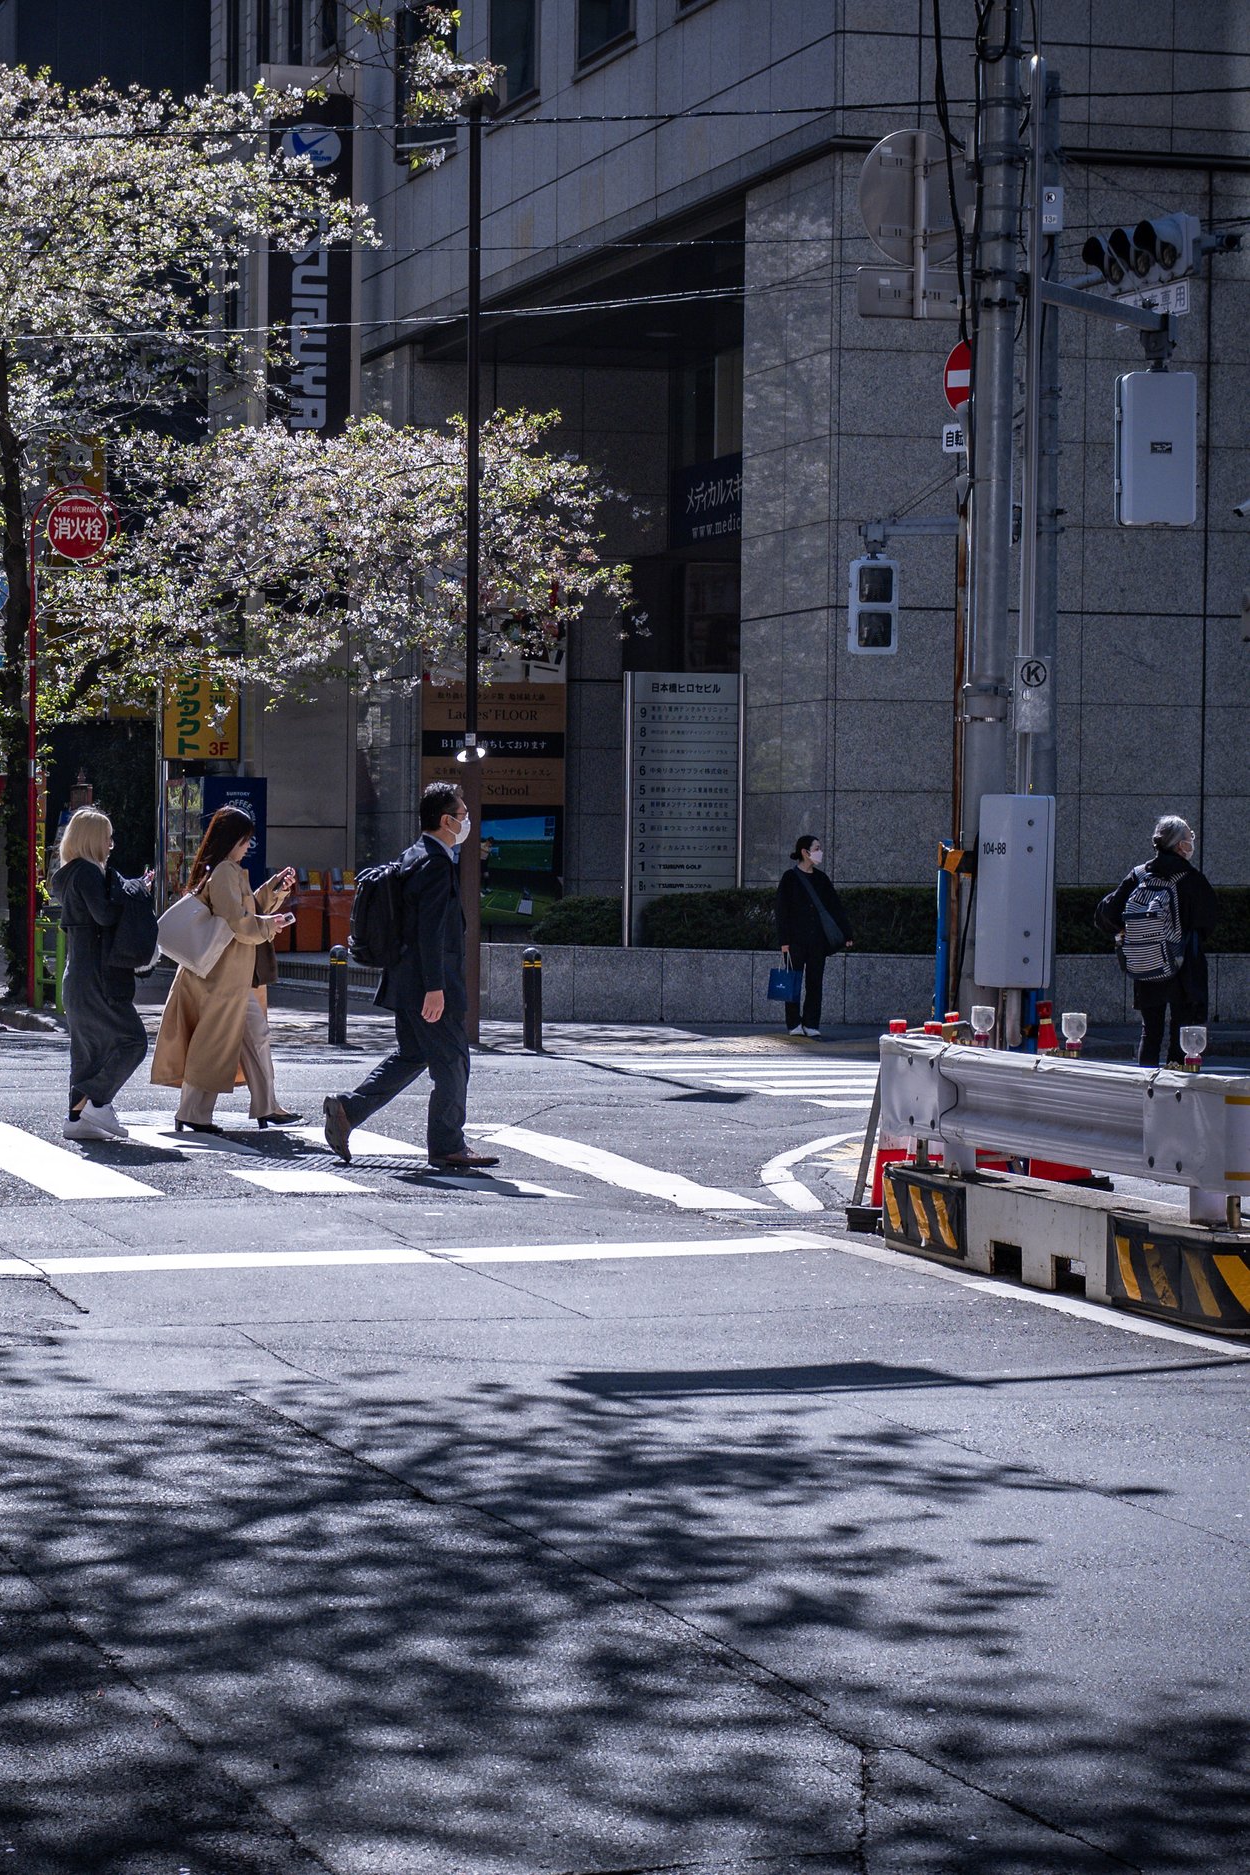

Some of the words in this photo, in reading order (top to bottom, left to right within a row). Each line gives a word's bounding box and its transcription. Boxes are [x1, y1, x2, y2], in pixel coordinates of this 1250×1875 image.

[58, 505, 71, 513] FIRE
[53, 516, 103, 540] 消火栓
[651, 683, 721, 694] 日本橋ヒロセビル
[495, 710, 538, 720] FLOOR
[640, 707, 647, 718] 9
[640, 726, 647, 737] 8
[209, 742, 230, 756] 3F
[640, 746, 646, 756] 7
[640, 765, 646, 776] 6
[487, 785, 529, 796] School
[639, 785, 646, 795] 5
[639, 803, 645, 814] 4
[639, 822, 646, 833] 3
[639, 842, 645, 852] 2
[982, 842, 1007, 855] 104-88
[638, 861, 645, 871] 1
